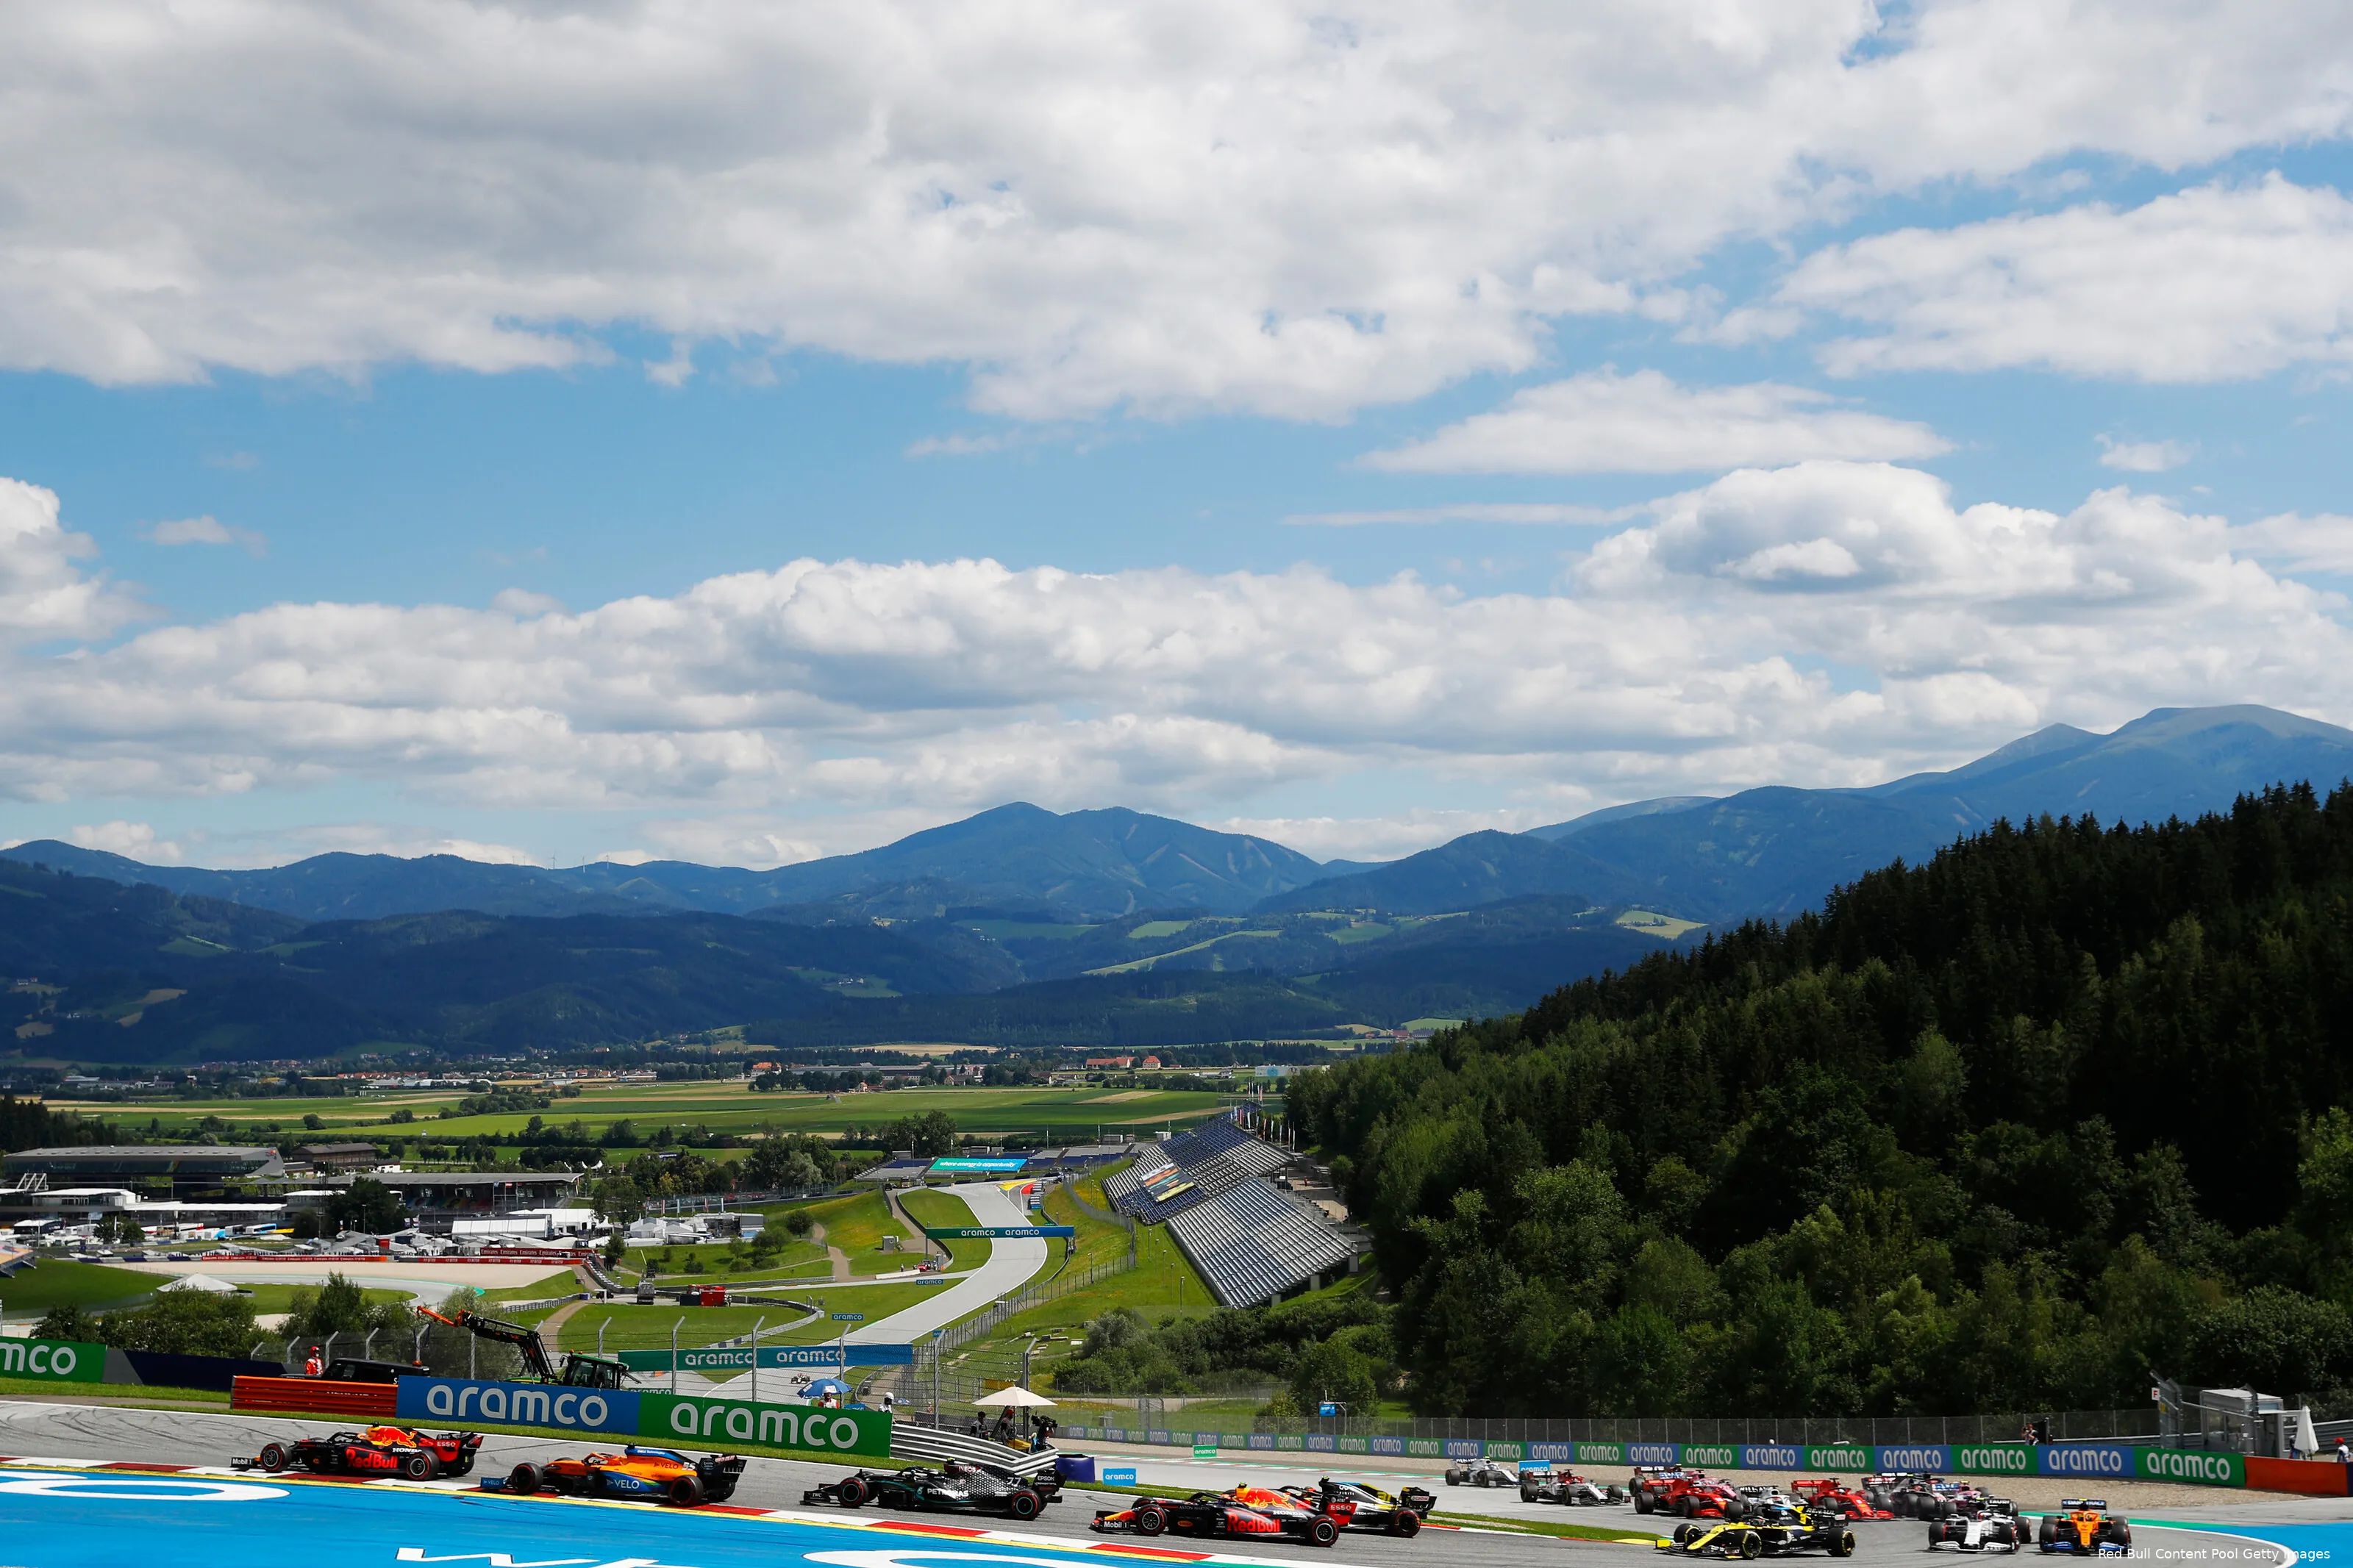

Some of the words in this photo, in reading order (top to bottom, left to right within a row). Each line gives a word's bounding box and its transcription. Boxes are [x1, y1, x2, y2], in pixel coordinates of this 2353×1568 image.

[426, 1384, 608, 1426] aramco
[671, 1403, 858, 1449] aramco
[1149, 1431, 1168, 1442] aramco
[1173, 1432, 1191, 1444] aramco
[1197, 1433, 1217, 1445] aramco
[1222, 1434, 1244, 1446] aramco
[1250, 1435, 1272, 1447] aramco
[1278, 1436, 1302, 1448] aramco
[1308, 1436, 1332, 1449] aramco
[1340, 1437, 1365, 1451] aramco
[1374, 1438, 1401, 1453] aramco
[1409, 1439, 1439, 1454] aramco
[1448, 1442, 1478, 1456] aramco
[1488, 1443, 1521, 1458] aramco
[1532, 1445, 1568, 1460] aramco
[1580, 1445, 1619, 1461] aramco
[1631, 1445, 1672, 1463] aramco
[1686, 1447, 1732, 1465] aramco
[1746, 1448, 1796, 1466] aramco
[1811, 1449, 1865, 1468] aramco
[1883, 1450, 1941, 1469] aramco
[1961, 1448, 2026, 1470] aramco
[2049, 1450, 2122, 1471] aramco
[2147, 1452, 2230, 1480] aramco
[615, 1480, 640, 1489] VELO
[1007, 1477, 1021, 1486] 77
